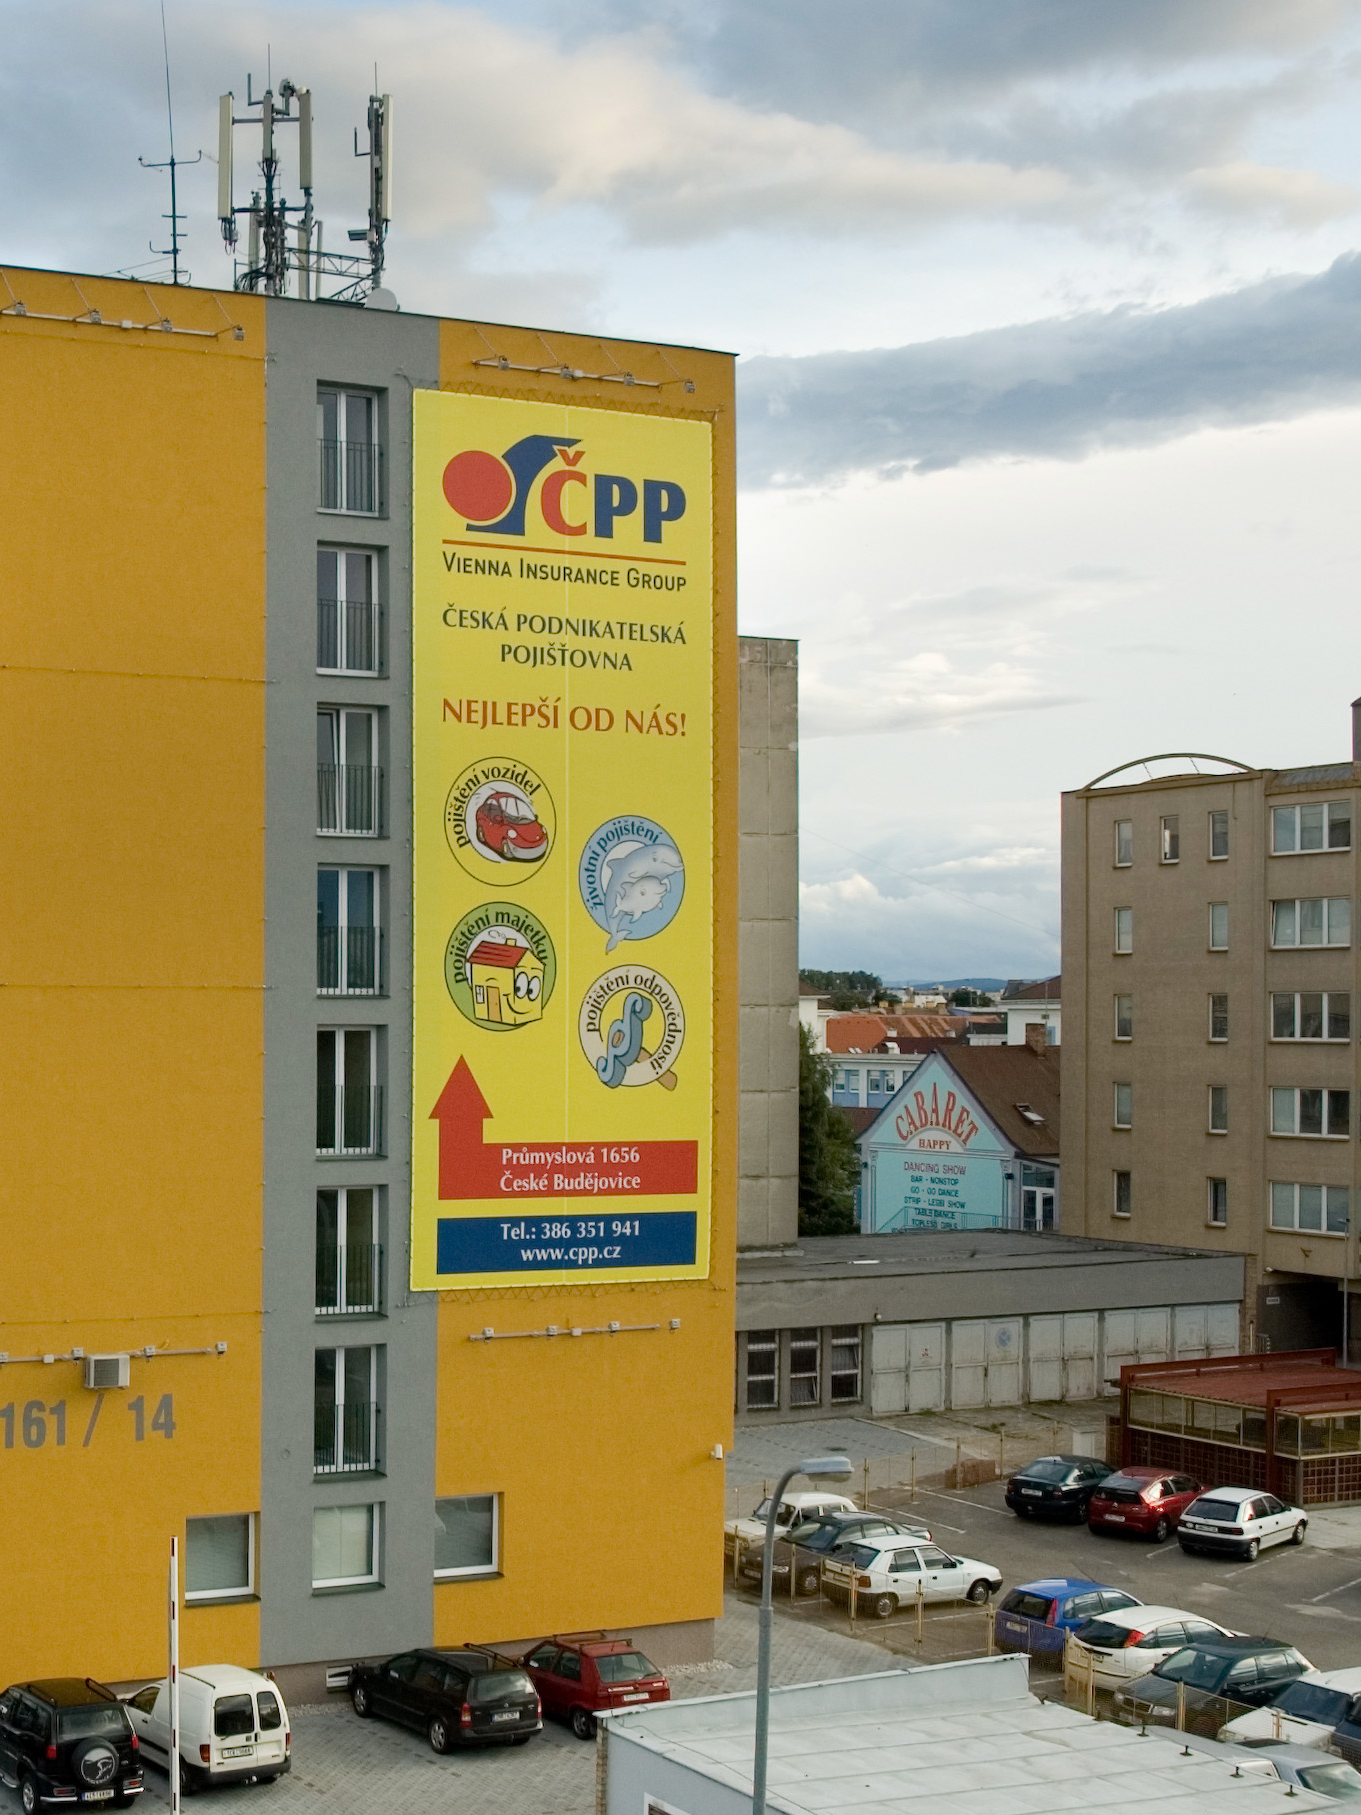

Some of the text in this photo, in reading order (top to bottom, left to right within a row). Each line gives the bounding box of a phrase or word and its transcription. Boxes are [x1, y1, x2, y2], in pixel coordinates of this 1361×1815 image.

[540, 447, 687, 544] ČPP
[442, 551, 687, 592] VIENNA INSURANCE GROUP
[442, 602, 687, 645] ČESKÁ PODNIKATELSKÁ
[500, 642, 633, 672] POJIŠŤOVNA
[442, 696, 687, 737] NEJLEPŠÍ OD NÁS!
[447, 763, 542, 849] pojištění vozidel
[584, 819, 663, 912] životní pojištění
[449, 908, 548, 985] pojištění majetku
[585, 968, 682, 1076] pojištění odpovědnosti
[895, 1082, 979, 1147] CABARET
[501, 1146, 640, 1169] Průmyslová 1656
[918, 1138, 952, 1151] HAPPY
[500, 1170, 641, 1194] České Budějovice
[904, 1161, 966, 1175] DANCING SHOW
[910, 1174, 923, 1183] BAR
[938, 1188, 959, 1197] DANCE
[947, 1200, 966, 1209] SHOW
[500, 1219, 640, 1240] Tel.: 386 351 941
[520, 1244, 622, 1266] www.cpp.cz
[127, 1393, 177, 1441] 14
